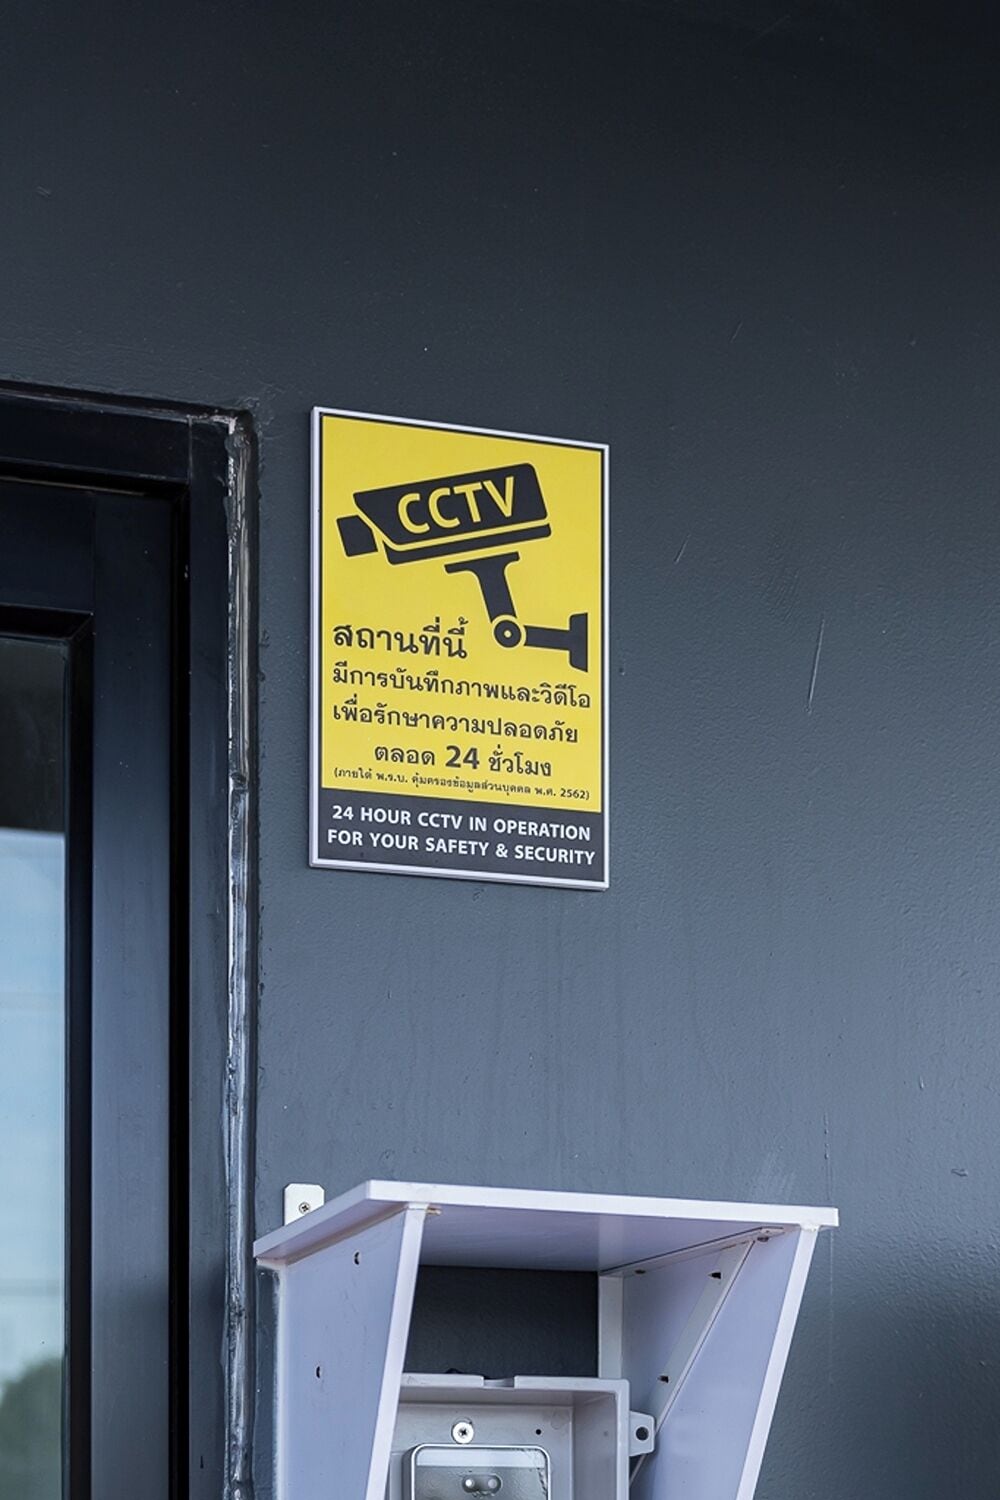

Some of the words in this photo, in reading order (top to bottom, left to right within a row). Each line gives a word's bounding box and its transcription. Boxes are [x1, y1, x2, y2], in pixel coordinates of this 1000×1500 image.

[398, 476, 514, 534] CCTV
[333, 616, 469, 659] สถานที่นี้
[332, 660, 591, 709] มีการบันทึกภาพและวิดีโอ
[332, 693, 579, 743] เพื่อรักษาความปลอดภัย
[374, 746, 435, 766] ตลอด
[445, 745, 480, 770] 24
[488, 744, 552, 777] ชั่วโมง
[560, 787, 590, 800] 2562)
[332, 805, 354, 820] 24
[360, 807, 411, 826] HOUR
[417, 812, 463, 830] CCTV
[469, 816, 487, 832] IN
[493, 818, 591, 841] OPERATION
[327, 829, 363, 846] FOR
[369, 832, 419, 851] YOUR
[425, 837, 490, 856] SAFETY
[495, 843, 509, 858] &
[514, 844, 596, 865] SECURITY
